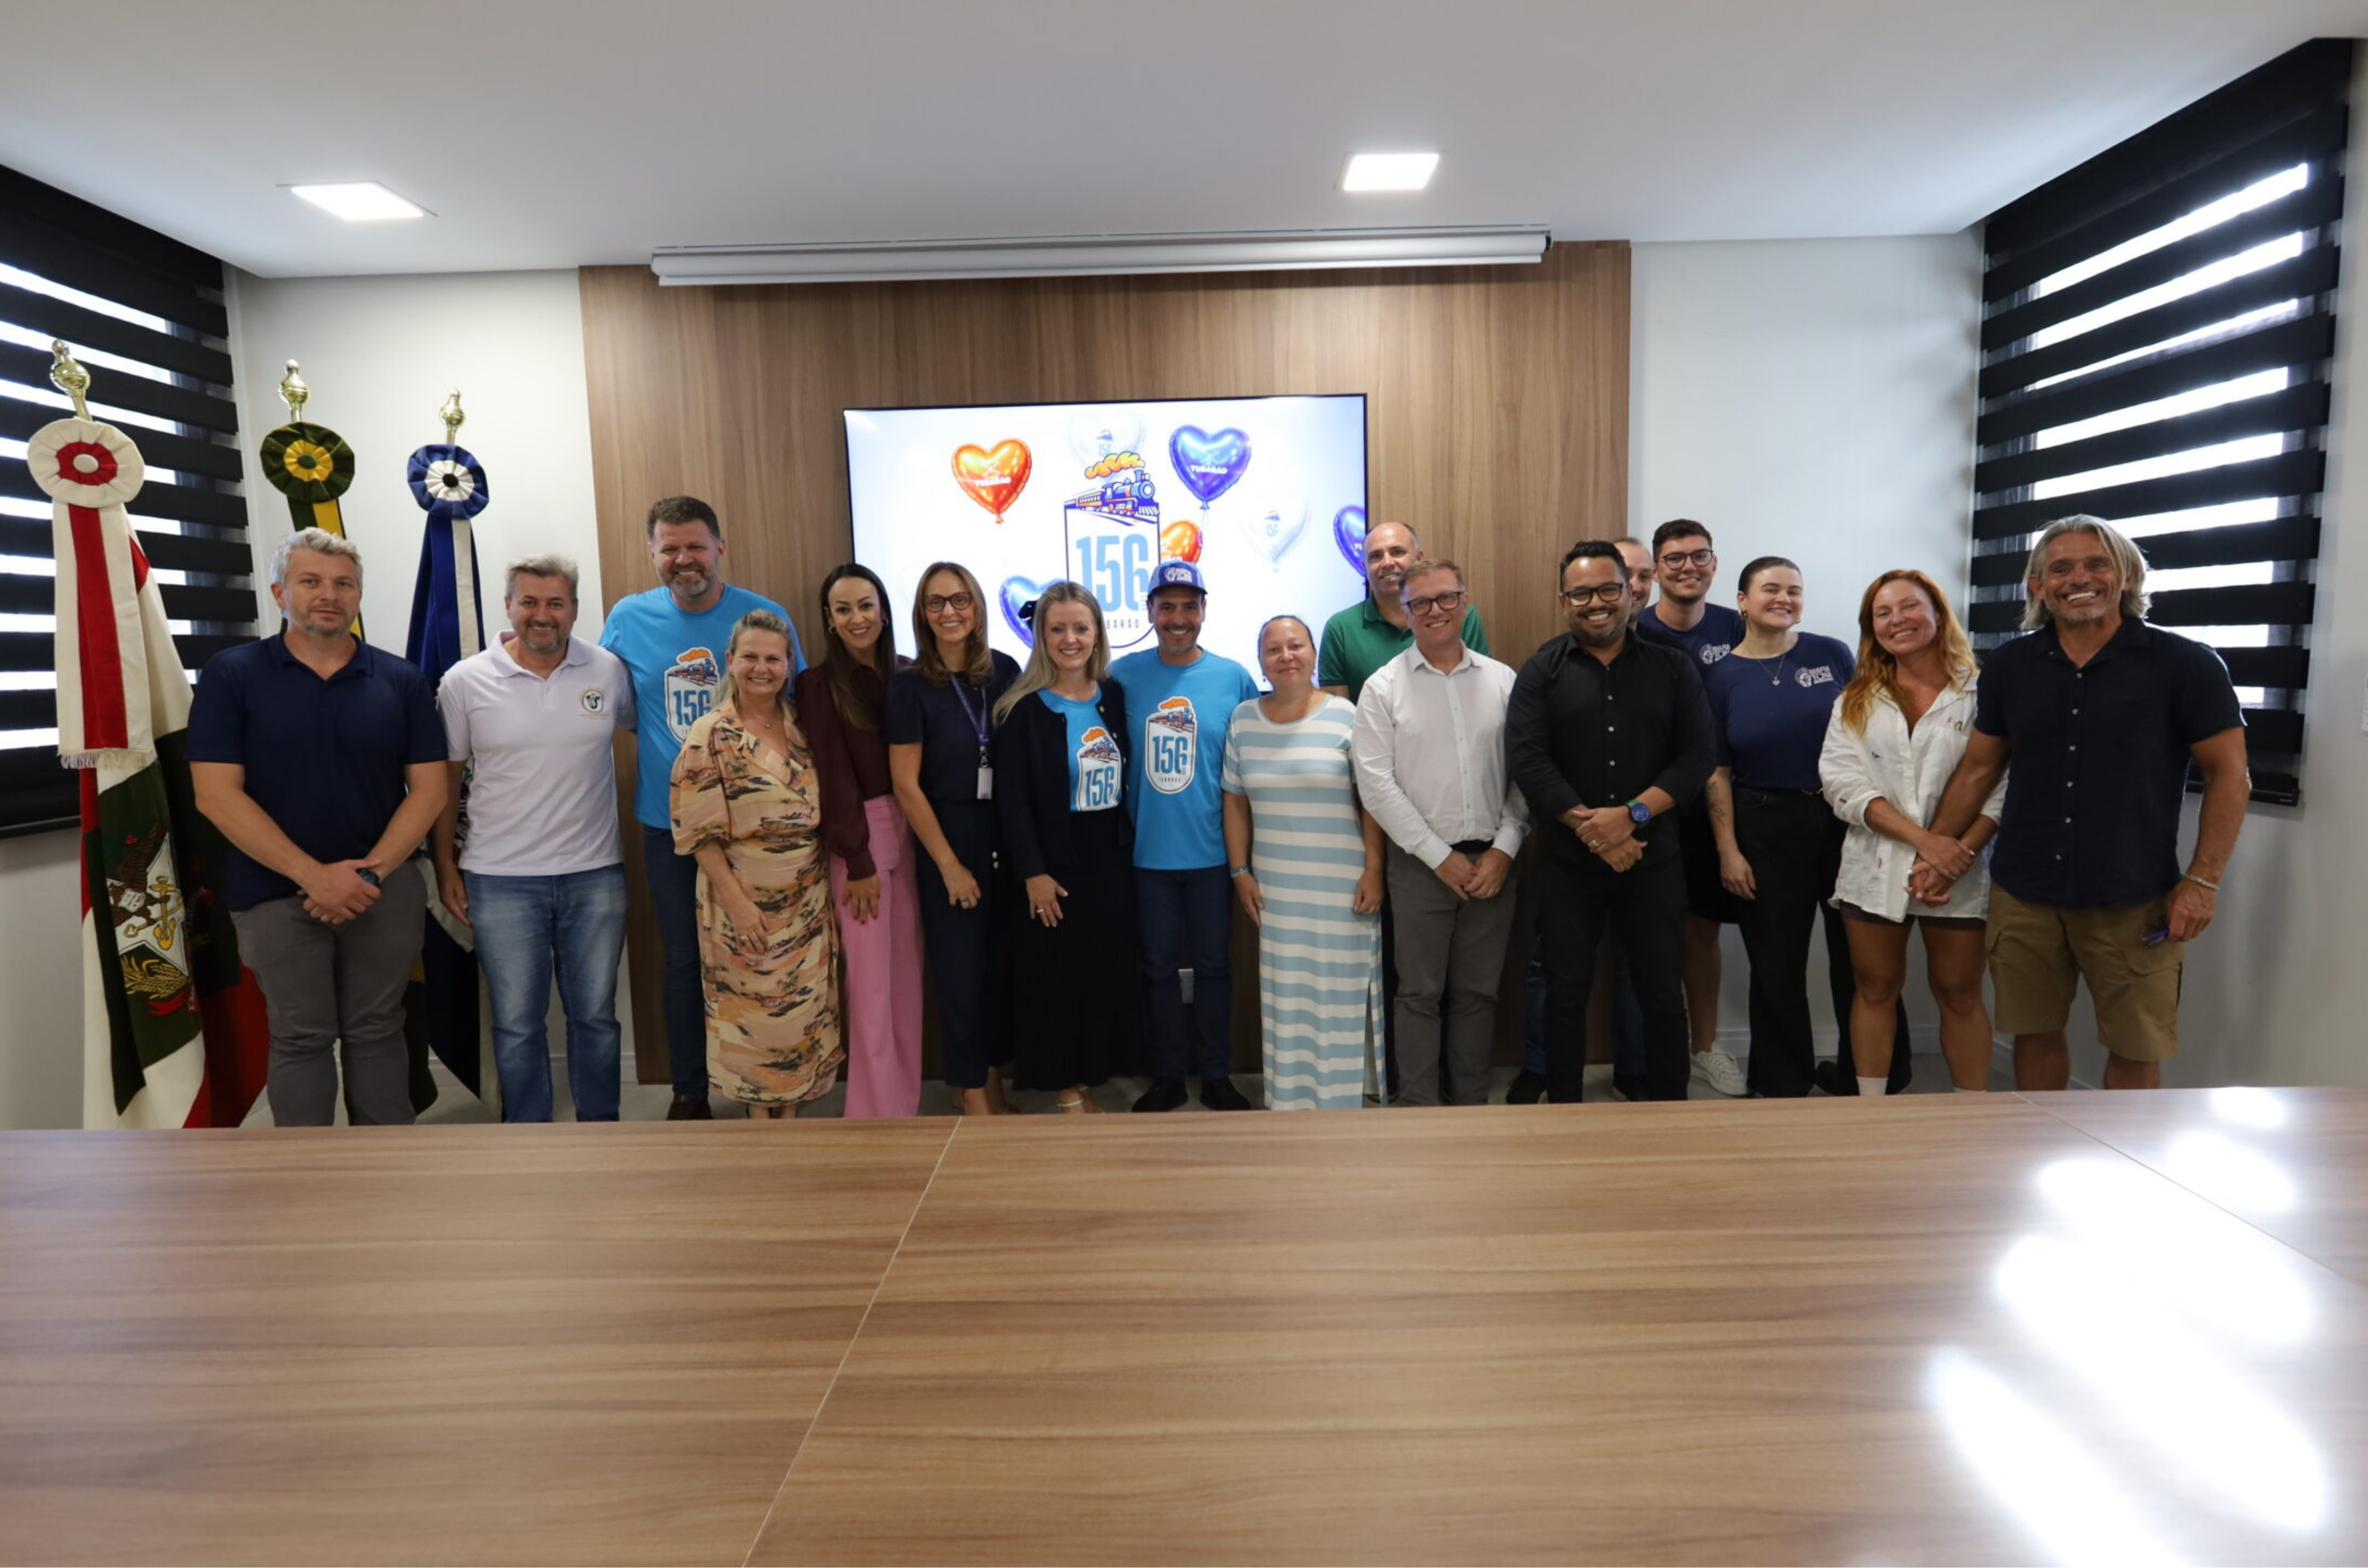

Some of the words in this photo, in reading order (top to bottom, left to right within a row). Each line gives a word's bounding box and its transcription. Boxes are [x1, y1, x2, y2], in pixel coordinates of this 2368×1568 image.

[1266, 523, 1279, 536] 156
[1076, 533, 1149, 612] 156
[1106, 616, 1140, 629] BARÃO
[673, 690, 712, 726] 156
[1153, 736, 1188, 775] 156
[1085, 766, 1115, 806] 156
